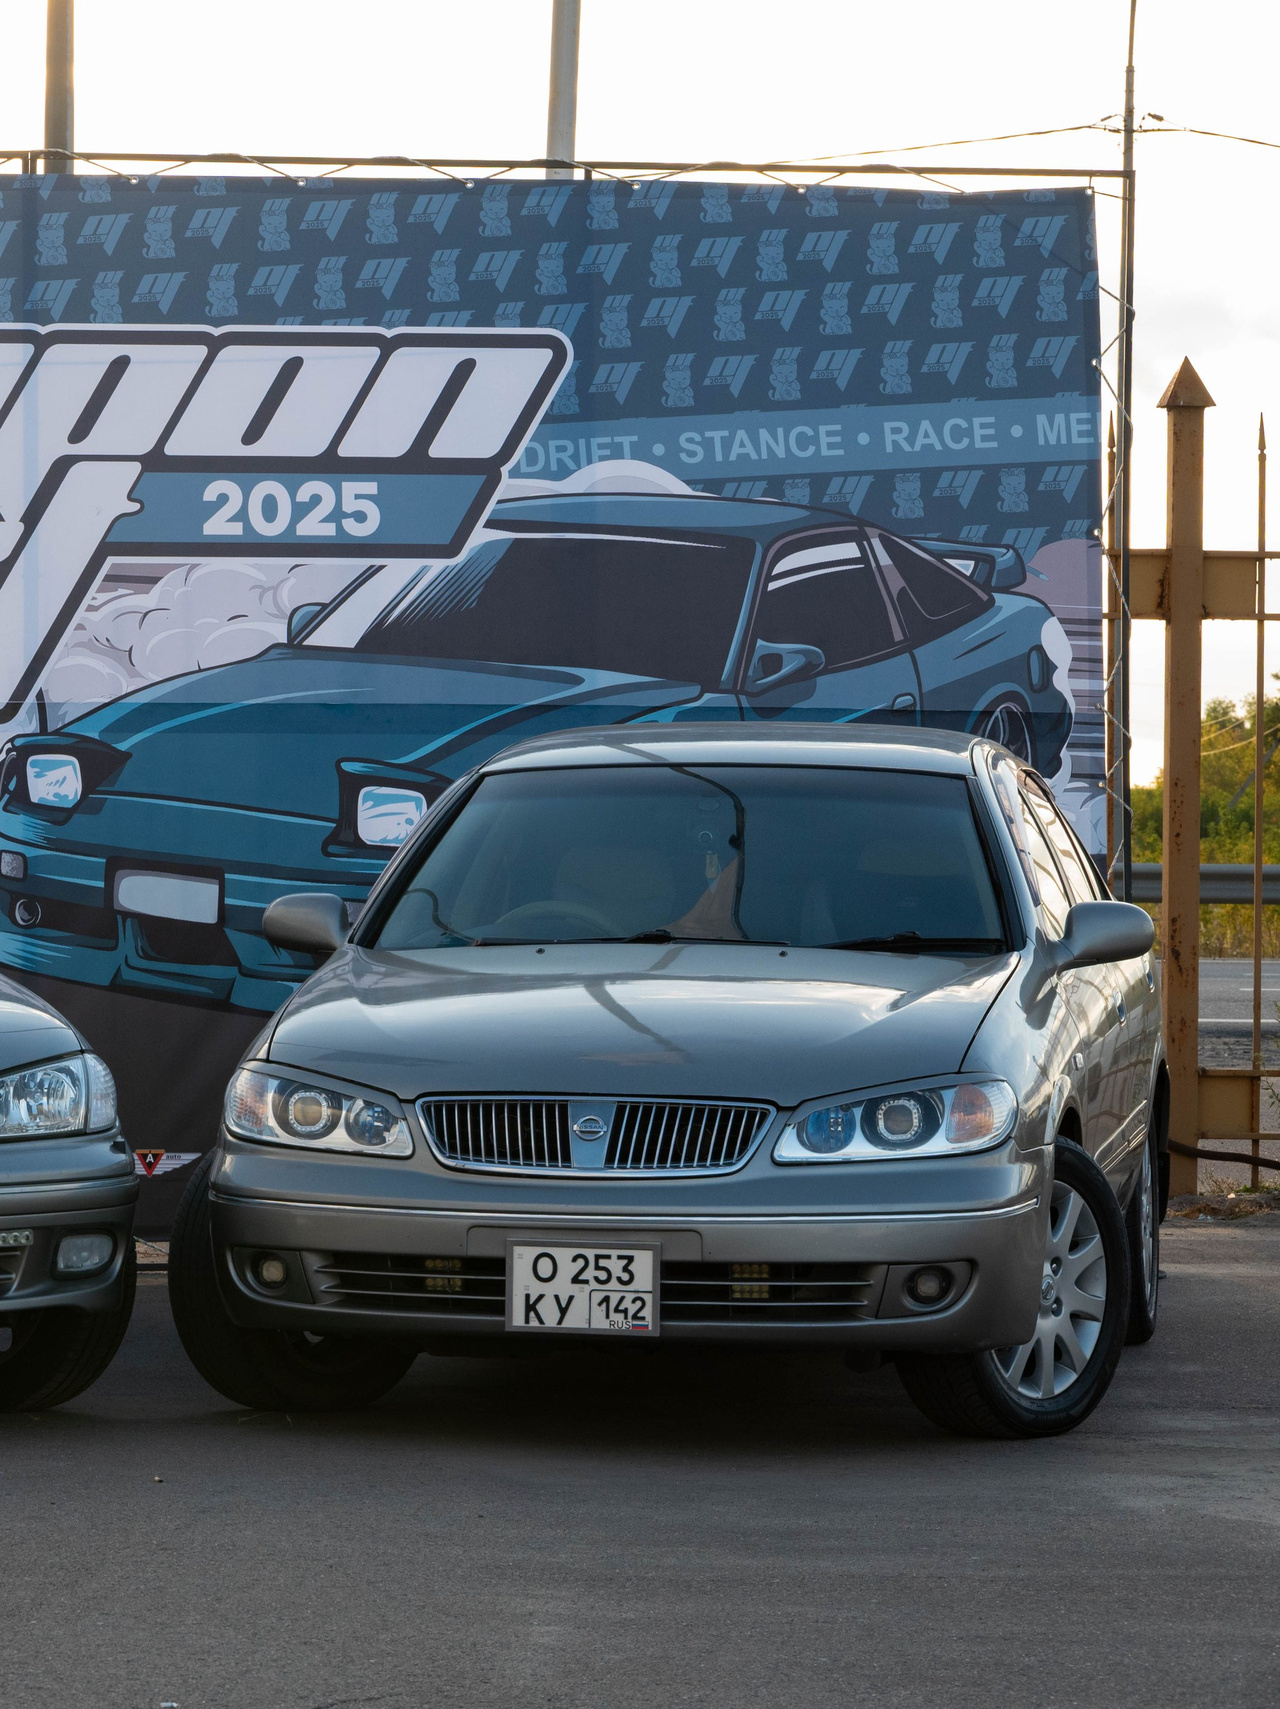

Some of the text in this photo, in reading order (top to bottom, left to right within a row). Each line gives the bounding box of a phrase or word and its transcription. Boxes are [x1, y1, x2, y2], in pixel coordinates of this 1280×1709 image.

[520, 412, 1101, 473] DRIFT STANCE RACE ME
[202, 480, 381, 537] 2025
[597, 1295, 646, 1321] 142
[609, 1320, 631, 1329] RUS
